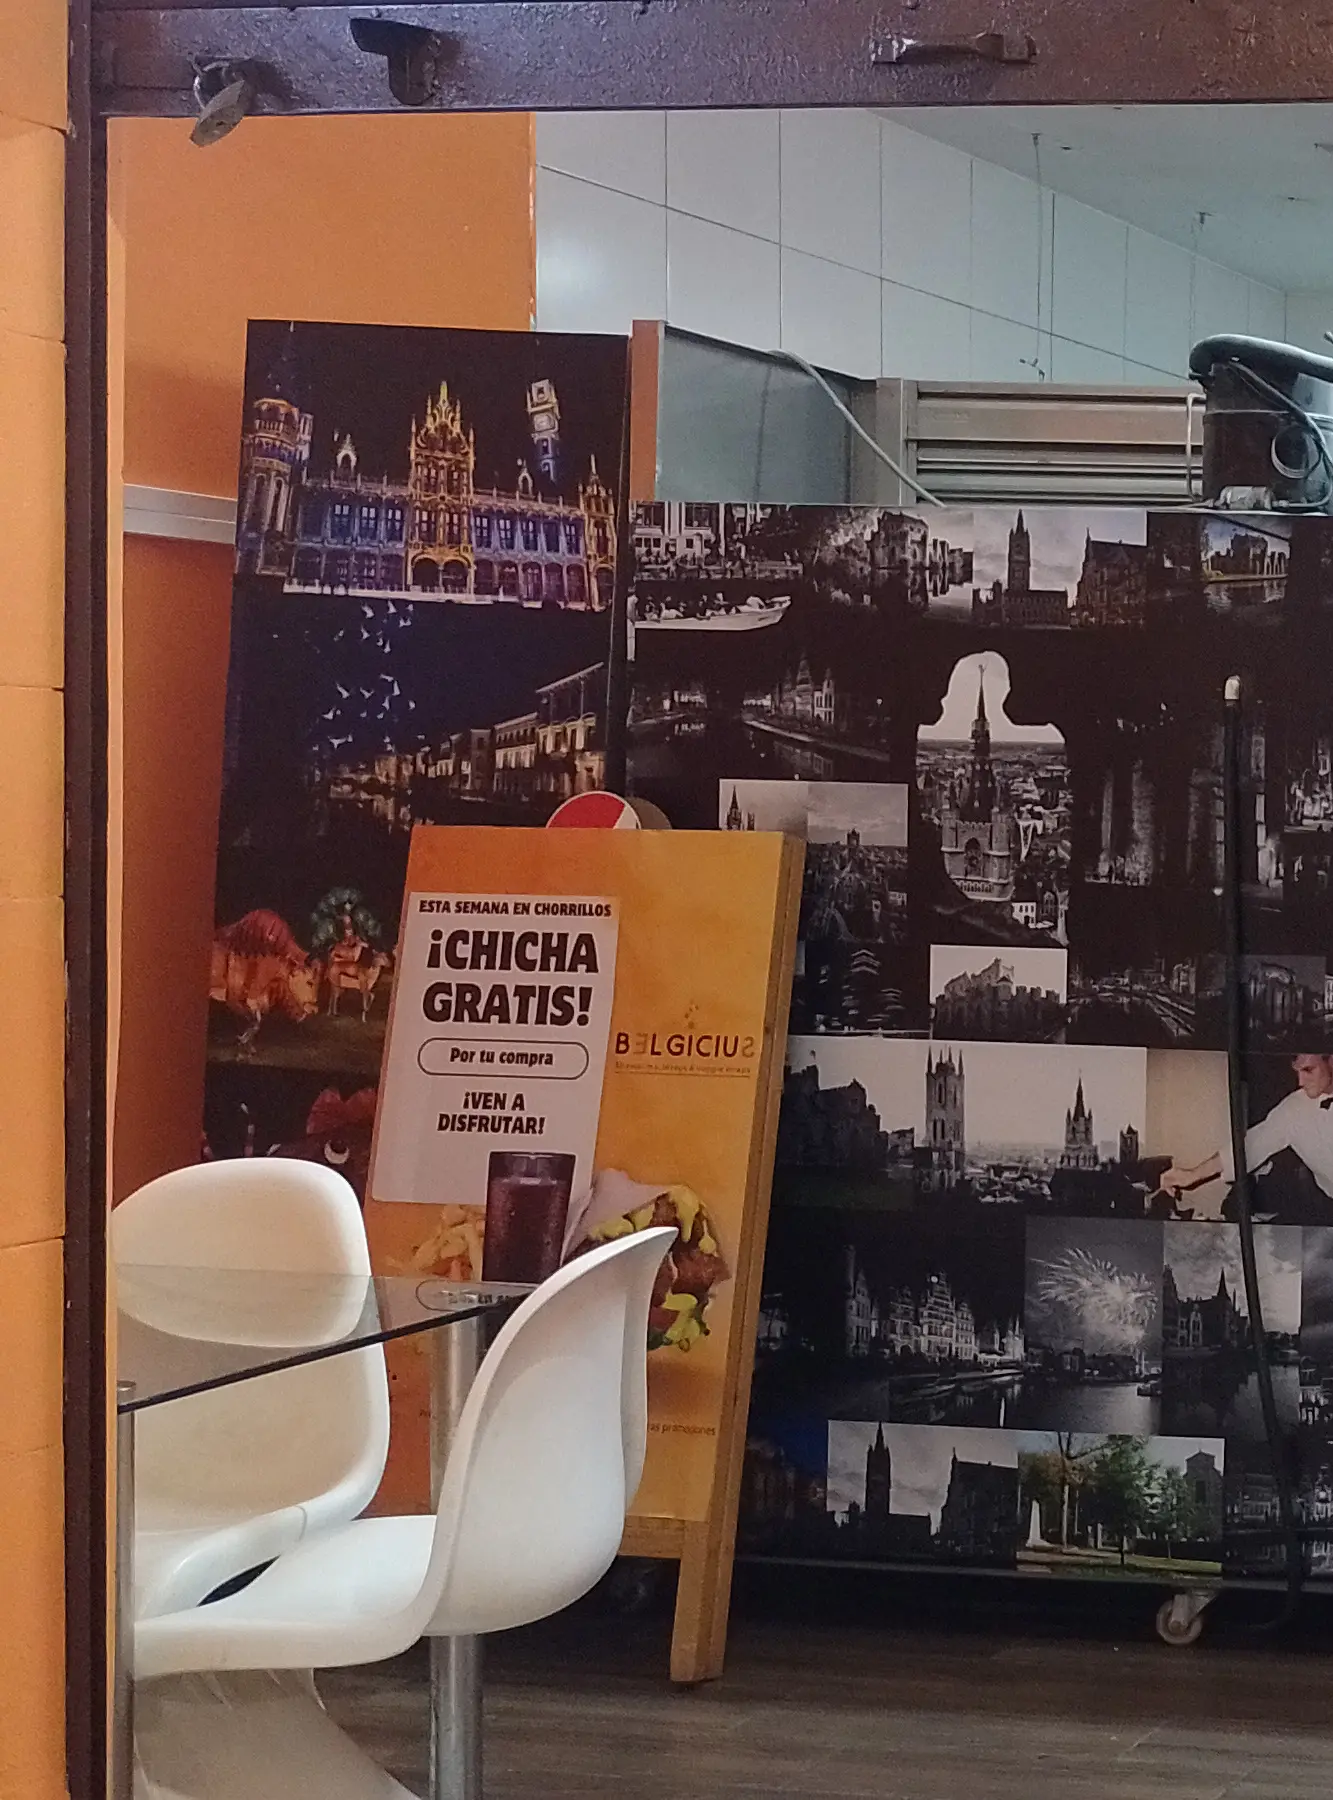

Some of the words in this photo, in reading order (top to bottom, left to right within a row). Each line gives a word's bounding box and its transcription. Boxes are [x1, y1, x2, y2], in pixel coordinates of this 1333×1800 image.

[419, 900, 450, 914] ESTA
[454, 901, 509, 915] SEMANA
[513, 902, 531, 915] EN
[534, 902, 612, 917] CHORRILLOS
[427, 929, 599, 974] ¡CHICHA
[422, 981, 593, 1026] GRATIS!
[449, 1047, 476, 1063] Por
[480, 1049, 495, 1064] tu
[499, 1051, 553, 1068] compra
[463, 1091, 507, 1111] ¡VEN
[511, 1093, 525, 1111] A
[437, 1113, 546, 1135] DISFRUTAR!
